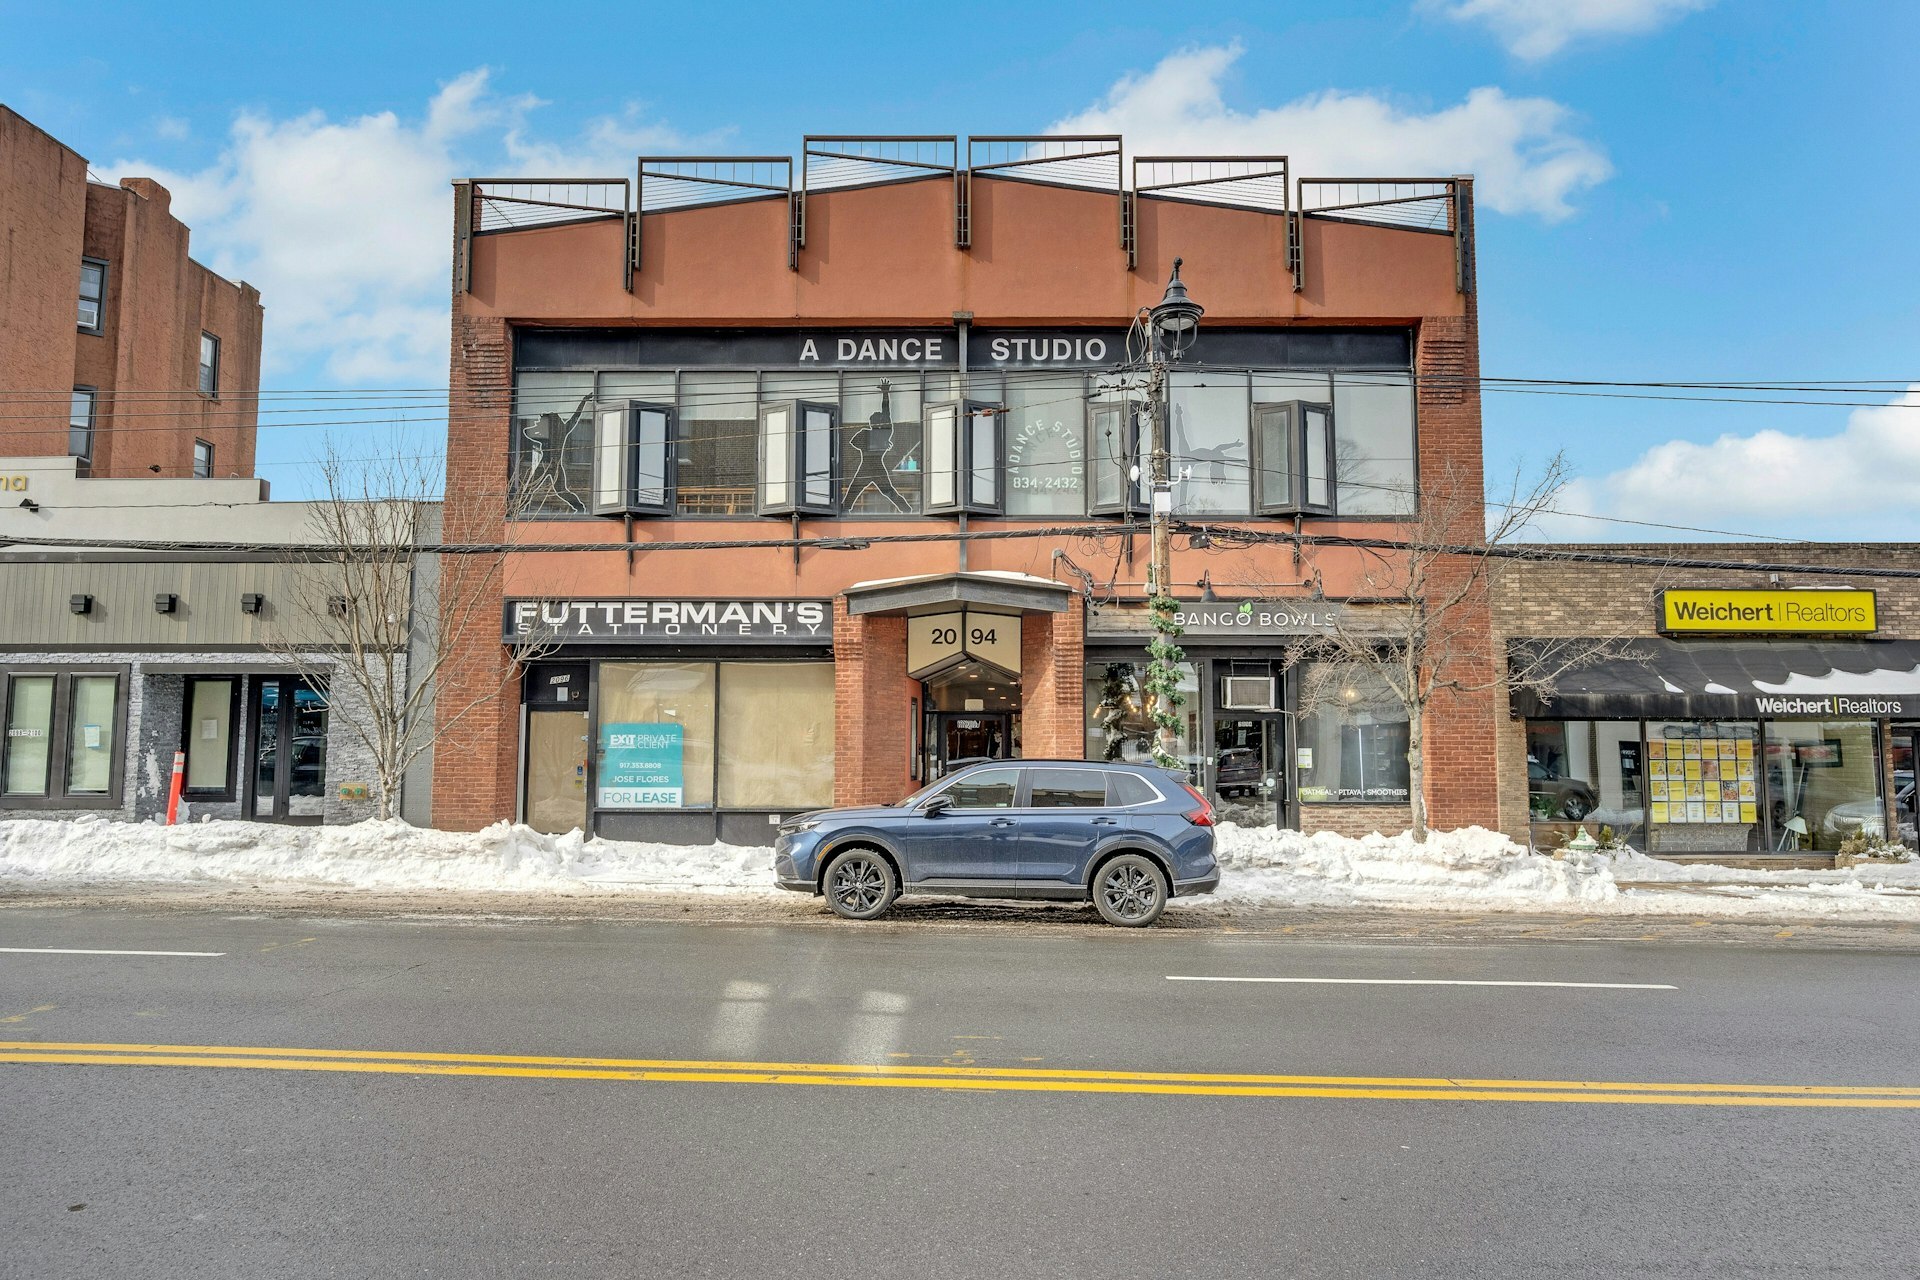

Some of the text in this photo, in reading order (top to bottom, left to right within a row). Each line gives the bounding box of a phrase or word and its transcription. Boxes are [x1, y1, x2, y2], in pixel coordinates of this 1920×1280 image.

[799, 338, 1107, 361] A DANCE STUDIO
[1007, 419, 1083, 475] A DANCE STUDIO
[1013, 476, 1078, 489] 834-2432
[514, 601, 824, 624] FUTTERMAN'S
[1673, 601, 1866, 622] Weichert Realtors
[1173, 612, 1337, 627] BANGO BOWLS
[517, 623, 821, 635] STATIONERY
[931, 628, 997, 645] 20 94
[550, 675, 570, 684] 2096
[1755, 697, 1902, 714] Weichert Realtors
[610, 734, 677, 746] EXIT PRIVATE
[637, 741, 669, 749] CLIENT
[612, 775, 670, 783] JOSE FLORES
[603, 792, 677, 804] FOR LEASE
[1302, 788, 1408, 796] OATMEAL PITAYA SMOOTHIES
